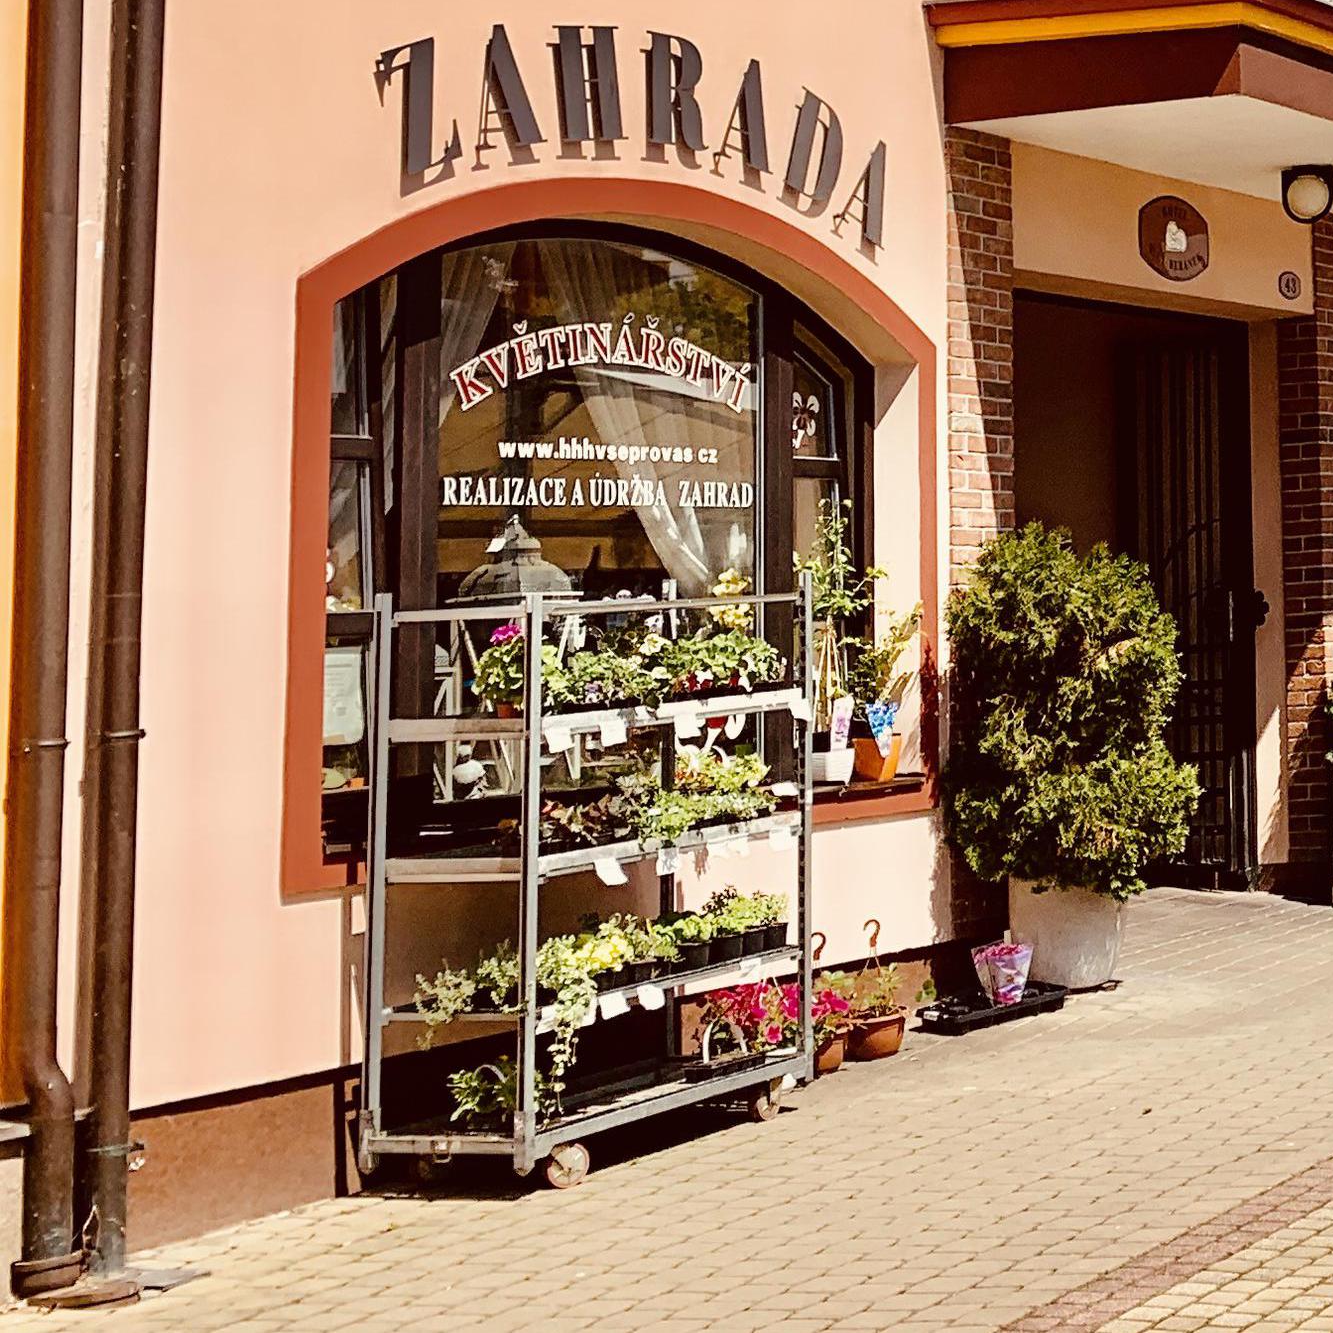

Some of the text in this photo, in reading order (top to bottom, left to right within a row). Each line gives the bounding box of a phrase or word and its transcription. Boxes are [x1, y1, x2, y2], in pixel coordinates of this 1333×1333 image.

[376, 24, 887, 260] ZAHRADA
[450, 313, 752, 414] KVĚTINÁŘSTVÍ
[442, 472, 754, 508] REALIZACE A ÚDRŽBA ZAHRAD
